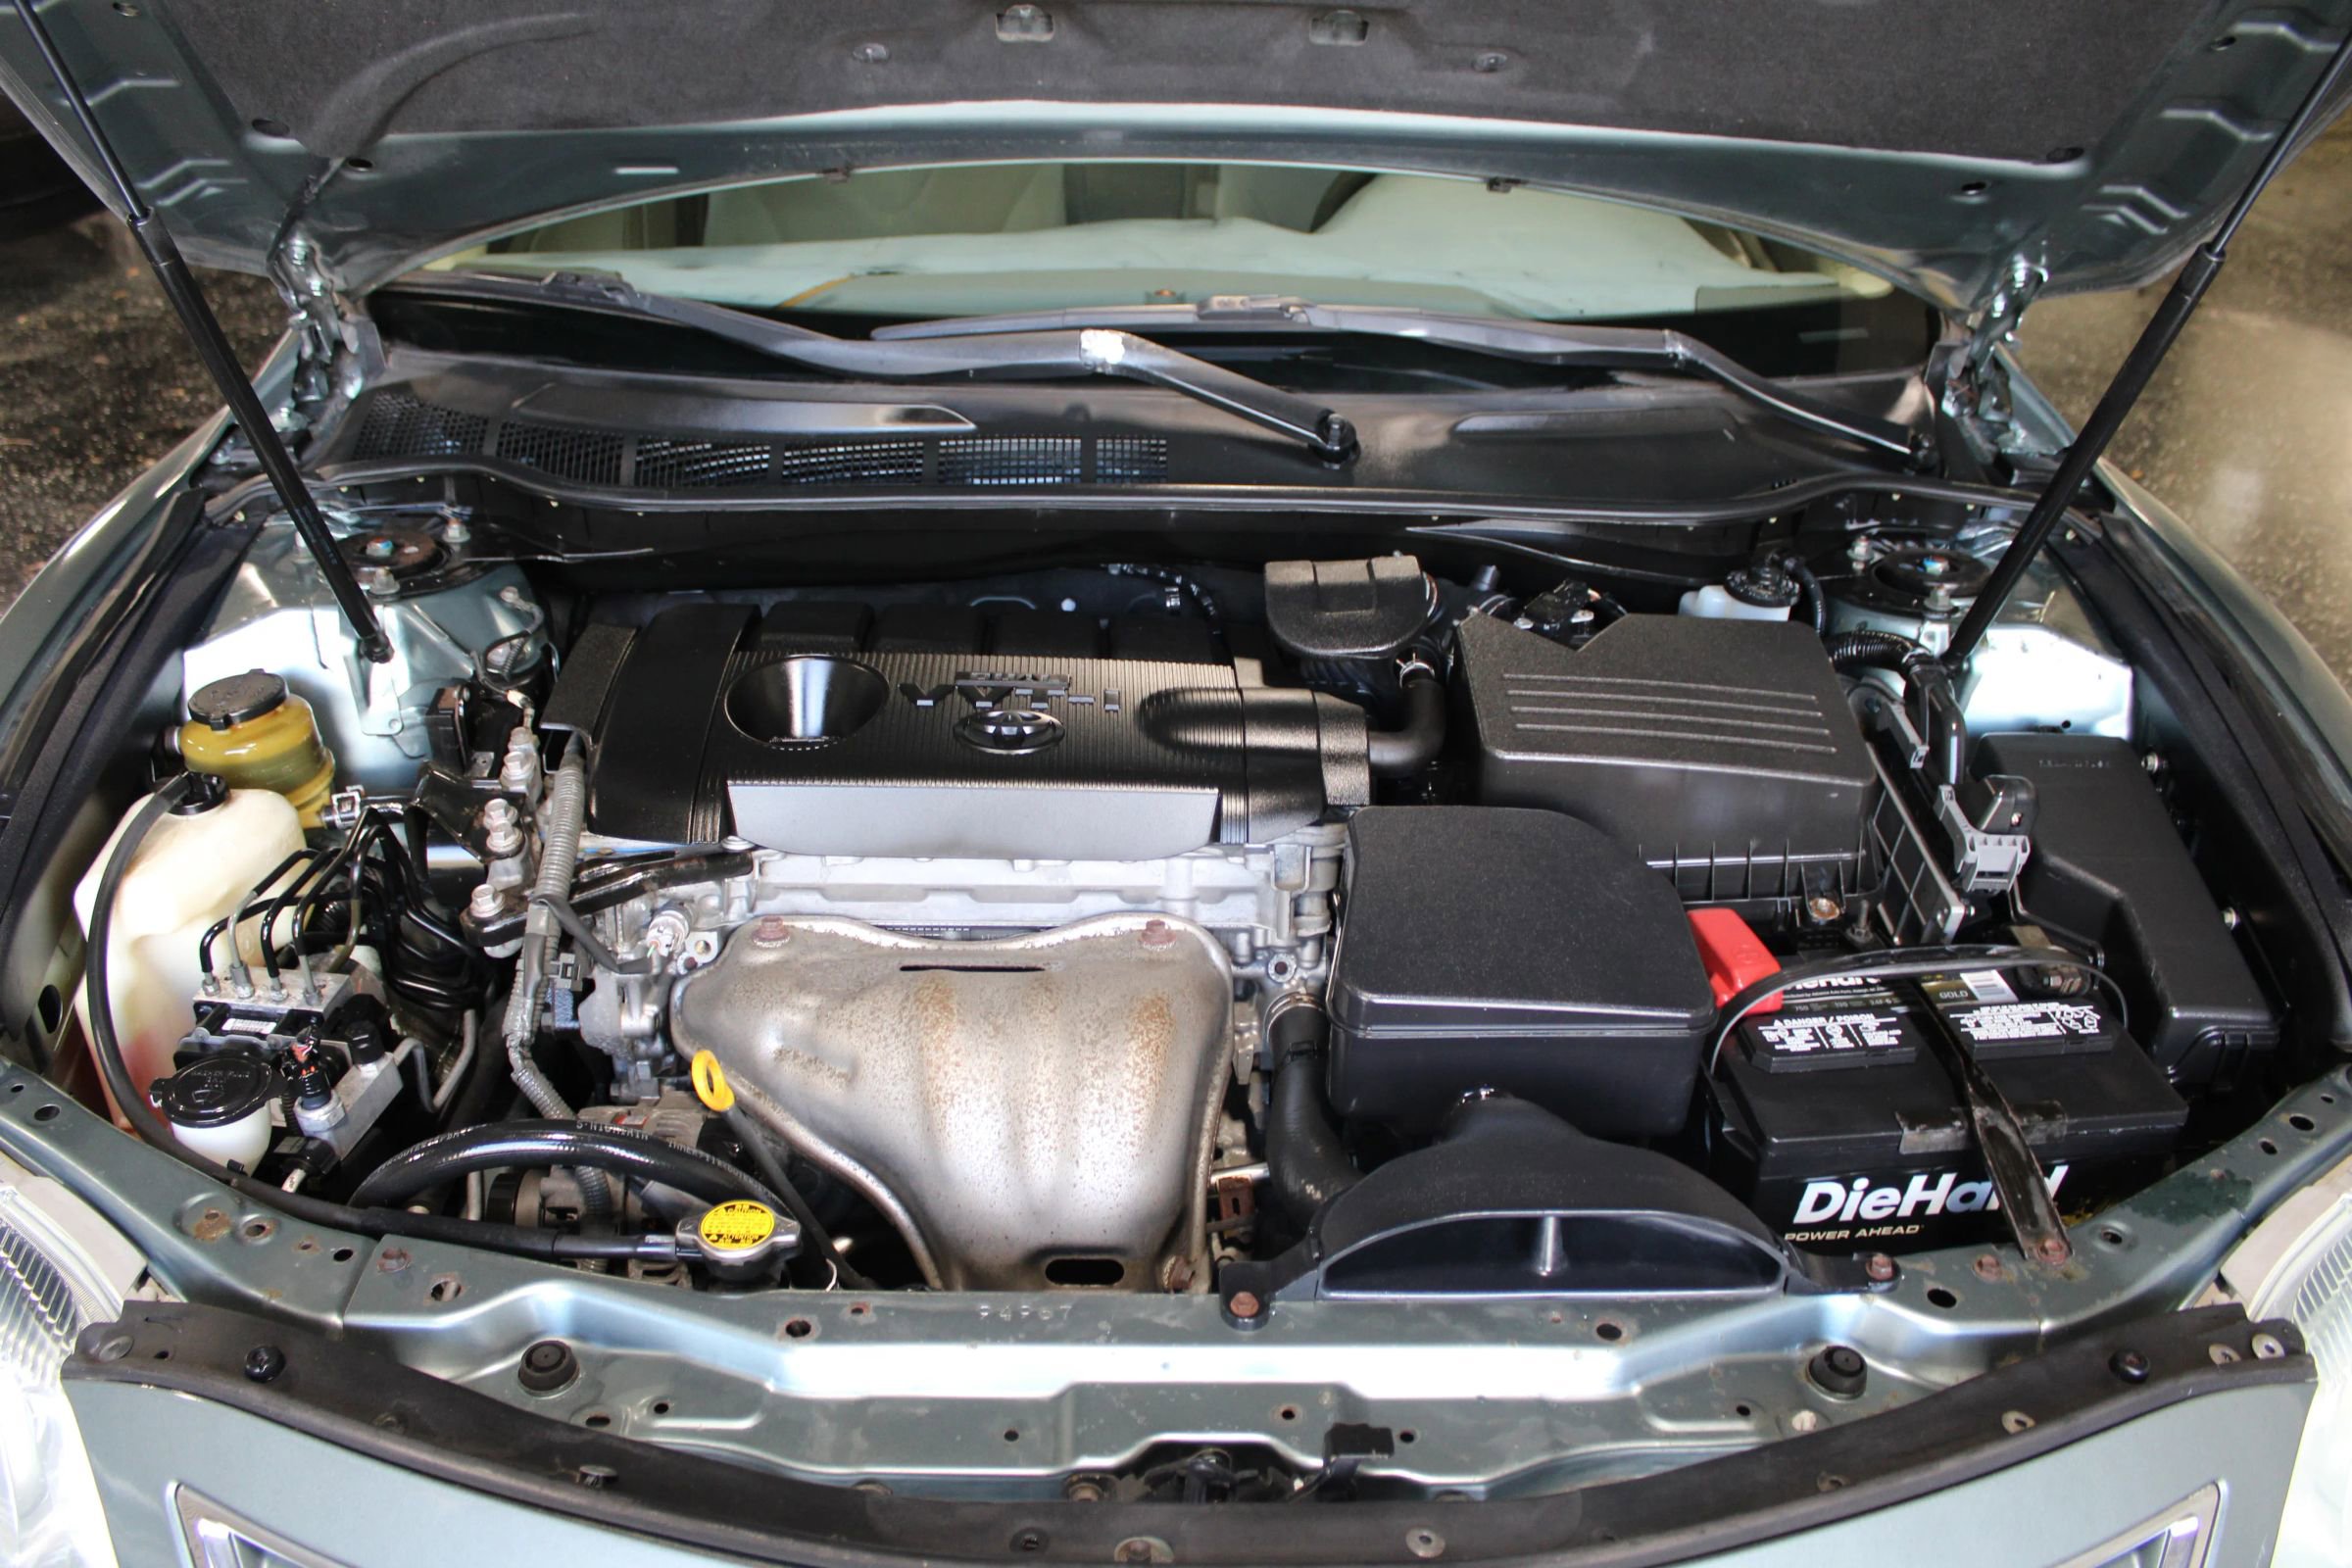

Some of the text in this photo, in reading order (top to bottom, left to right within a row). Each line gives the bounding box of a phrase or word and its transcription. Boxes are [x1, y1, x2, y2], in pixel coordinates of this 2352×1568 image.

[1938, 990, 1969, 1000] GOLD
[1785, 1224, 1921, 1242] POWER AHEAD
